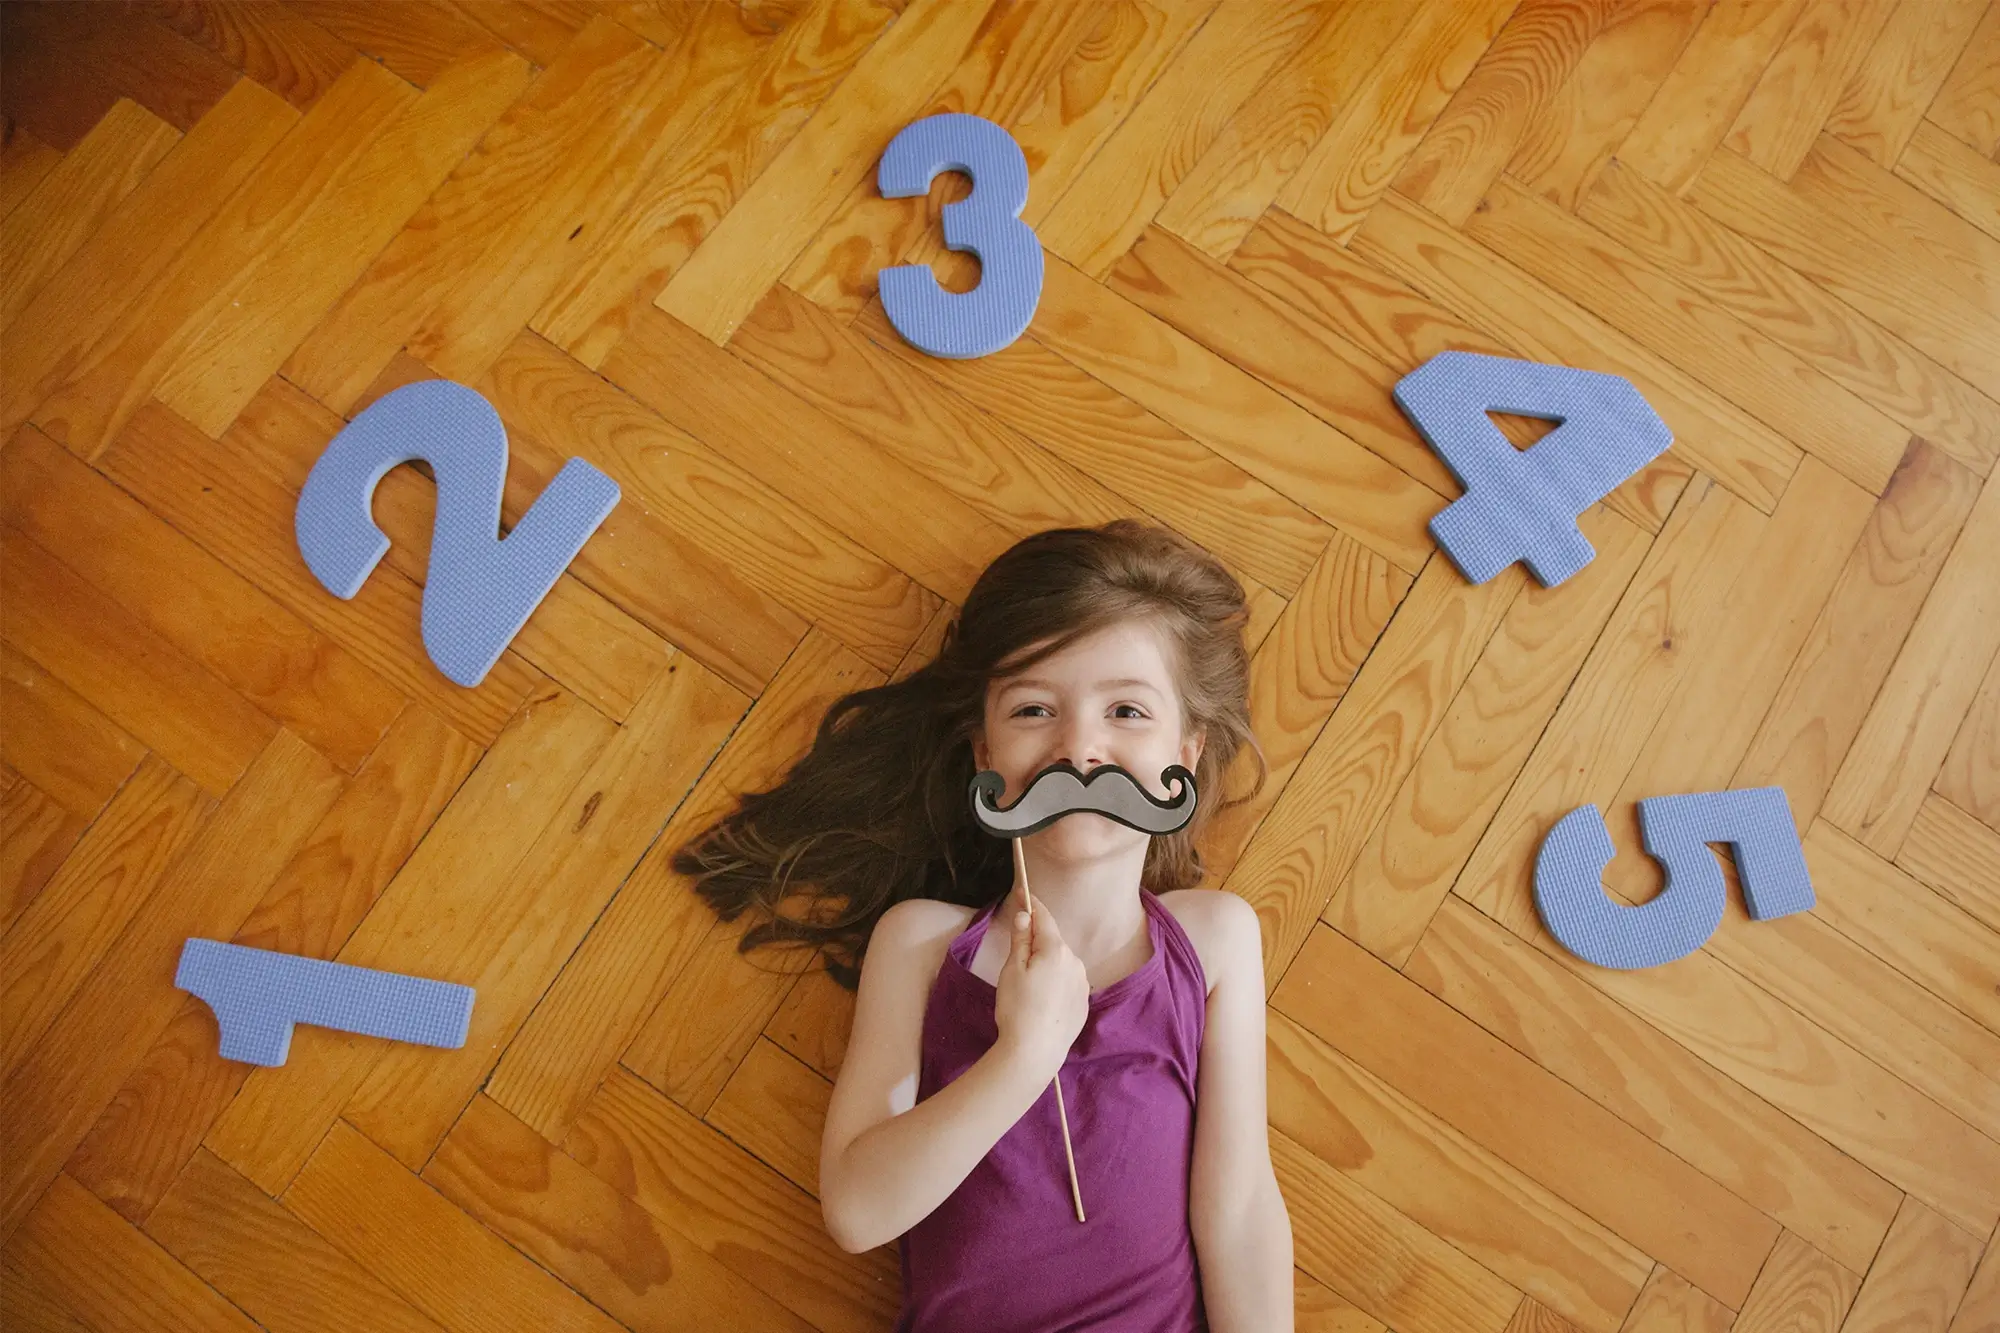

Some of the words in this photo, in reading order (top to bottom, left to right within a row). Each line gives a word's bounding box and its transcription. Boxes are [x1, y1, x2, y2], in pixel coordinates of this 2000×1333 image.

[878, 112, 1045, 359] 3
[295, 379, 621, 688] 2
[1393, 350, 1674, 589] 4
[1533, 786, 1816, 970] 5
[174, 937, 476, 1068] 1
